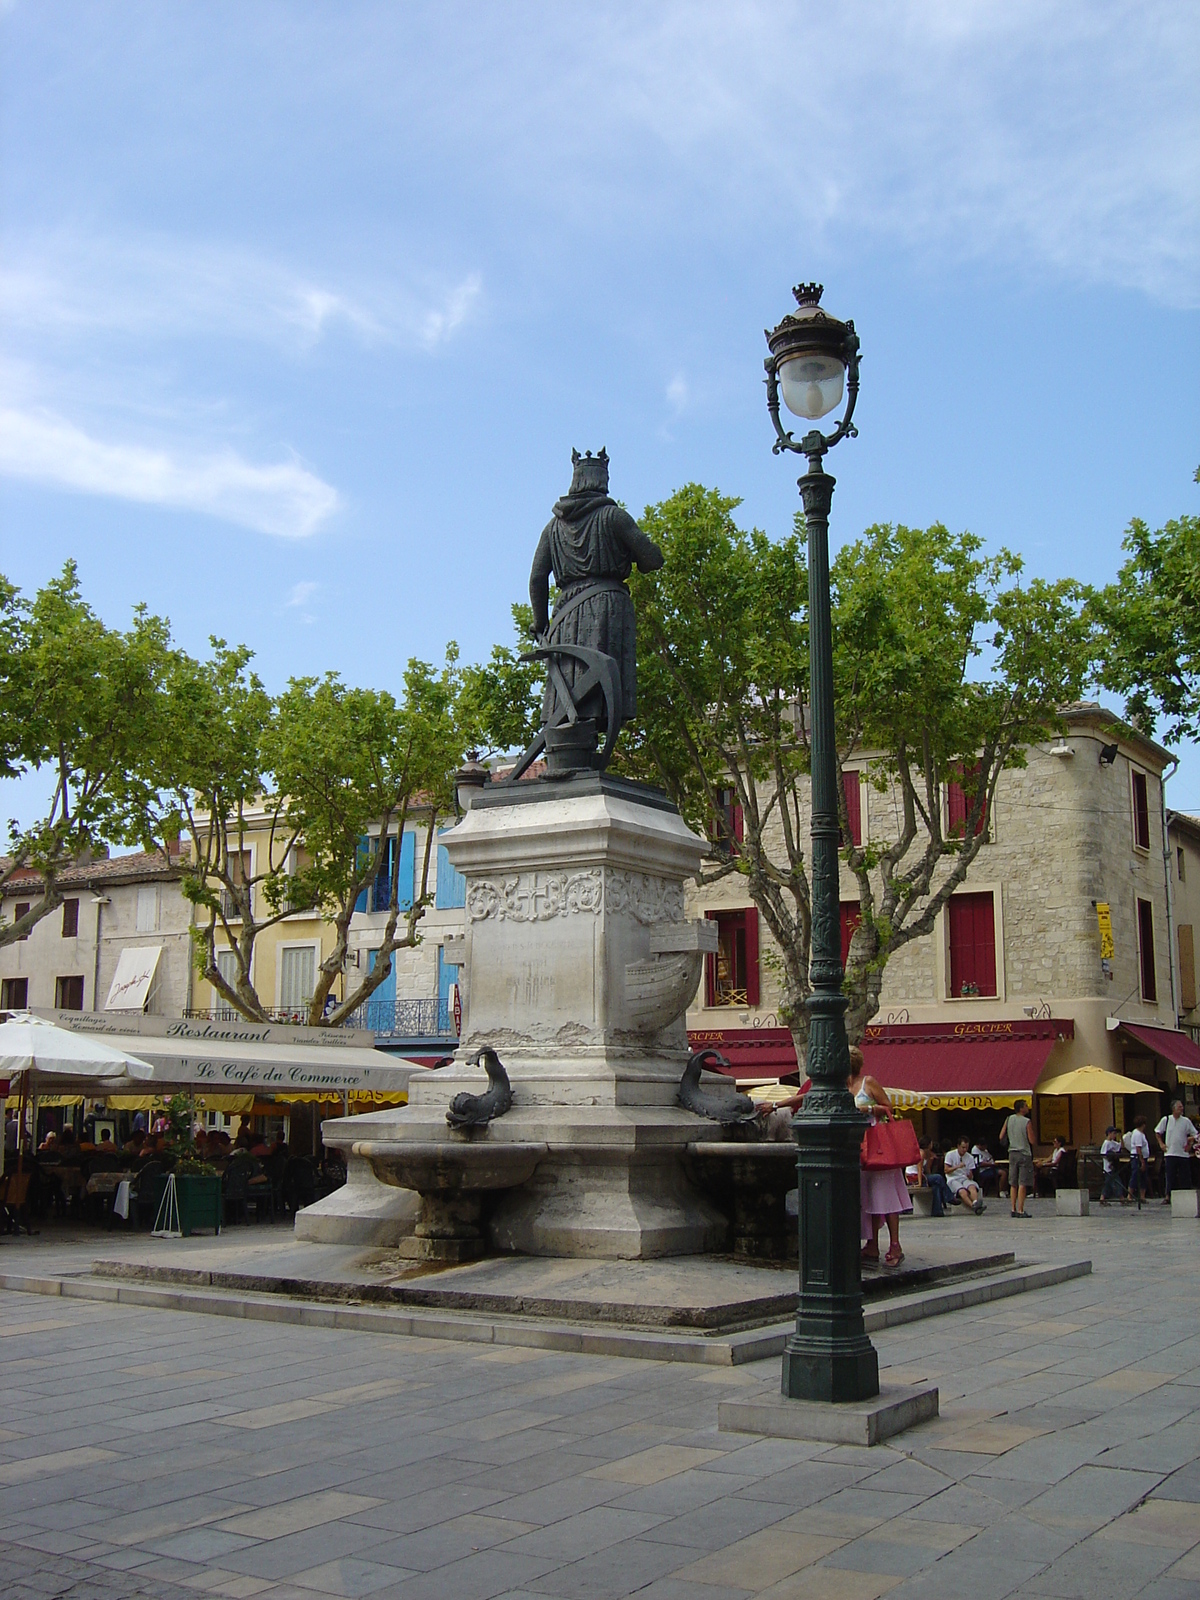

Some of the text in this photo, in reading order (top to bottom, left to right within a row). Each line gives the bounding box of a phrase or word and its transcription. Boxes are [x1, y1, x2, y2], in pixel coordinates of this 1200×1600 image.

[58, 1013, 107, 1024] Coquillages
[105, 1024, 117, 1032] du
[166, 1021, 271, 1041] Restaurant
[954, 1023, 1014, 1036] GLACIER
[221, 1064, 260, 1083] Café
[263, 1067, 284, 1081] du
[947, 1096, 993, 1107] LUNA
